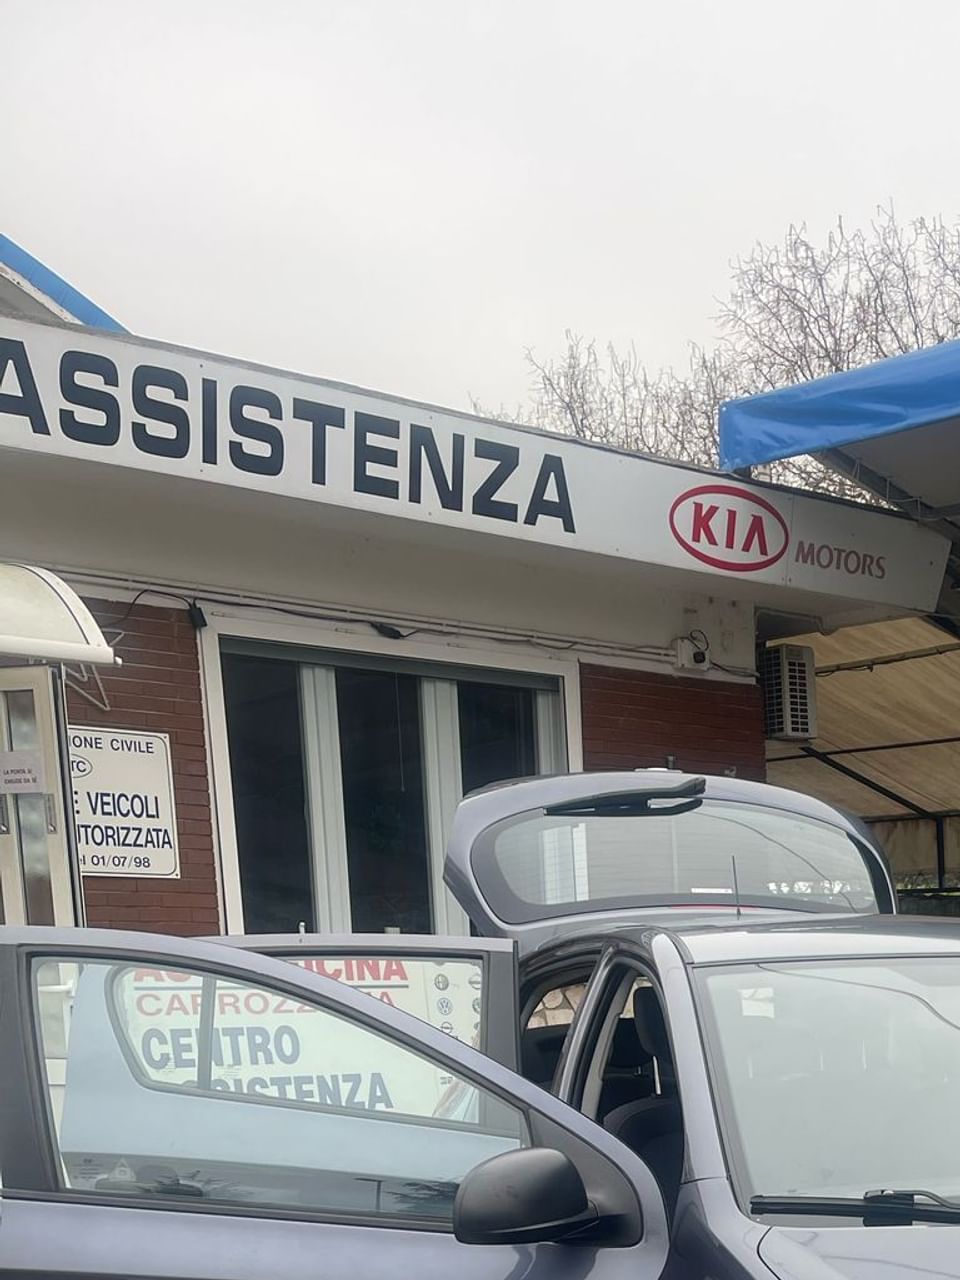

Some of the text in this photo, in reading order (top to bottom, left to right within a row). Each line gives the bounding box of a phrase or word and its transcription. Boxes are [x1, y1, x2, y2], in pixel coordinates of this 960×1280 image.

[0, 336, 577, 534] ASSISTENZA
[691, 501, 769, 557] KIA
[794, 539, 887, 580] MOTORS
[110, 738, 155, 754] CIVILE
[86, 791, 160, 819] VEICOLI
[91, 854, 151, 869] 01/07/98
